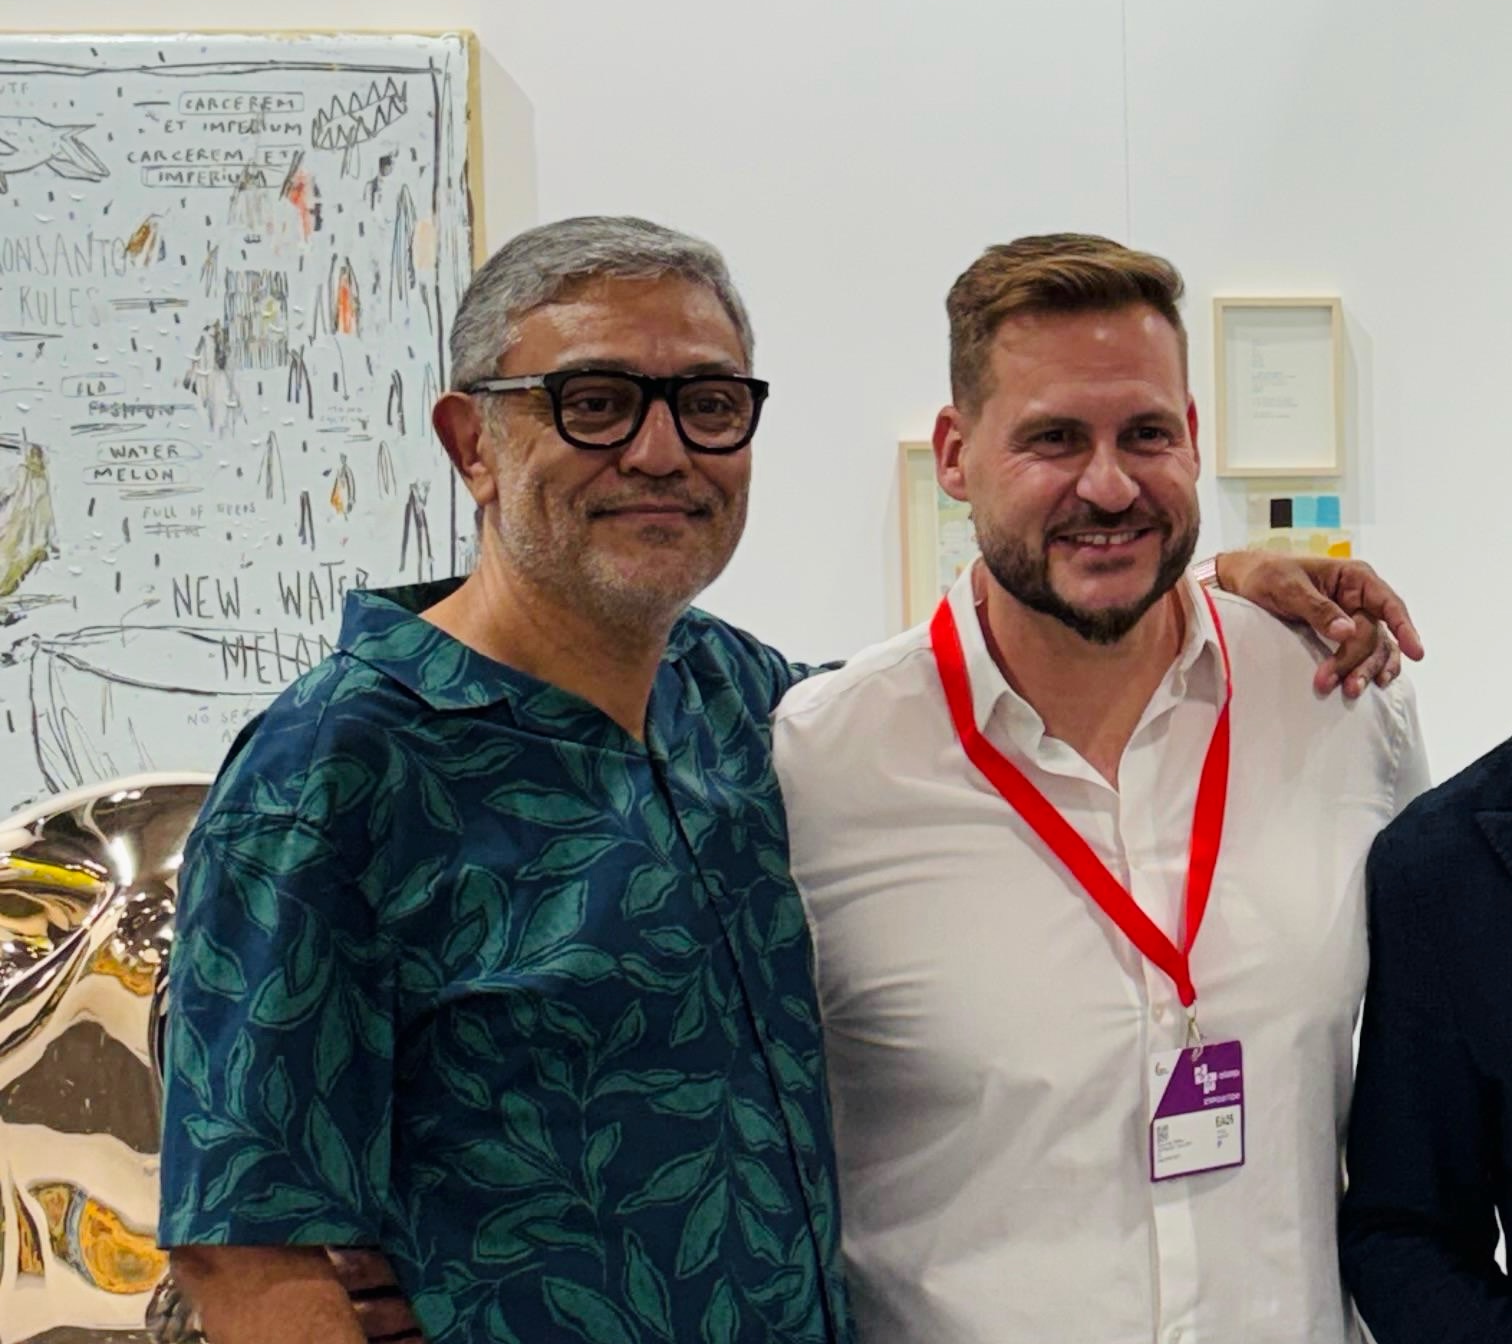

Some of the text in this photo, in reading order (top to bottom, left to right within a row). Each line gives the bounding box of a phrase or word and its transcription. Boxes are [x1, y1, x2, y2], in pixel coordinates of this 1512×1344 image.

[185, 97, 295, 111] CARCEREM
[164, 120, 186, 134] ET
[127, 147, 244, 163] CARCEREM
[109, 444, 180, 460] WATER
[94, 467, 175, 482] MELON
